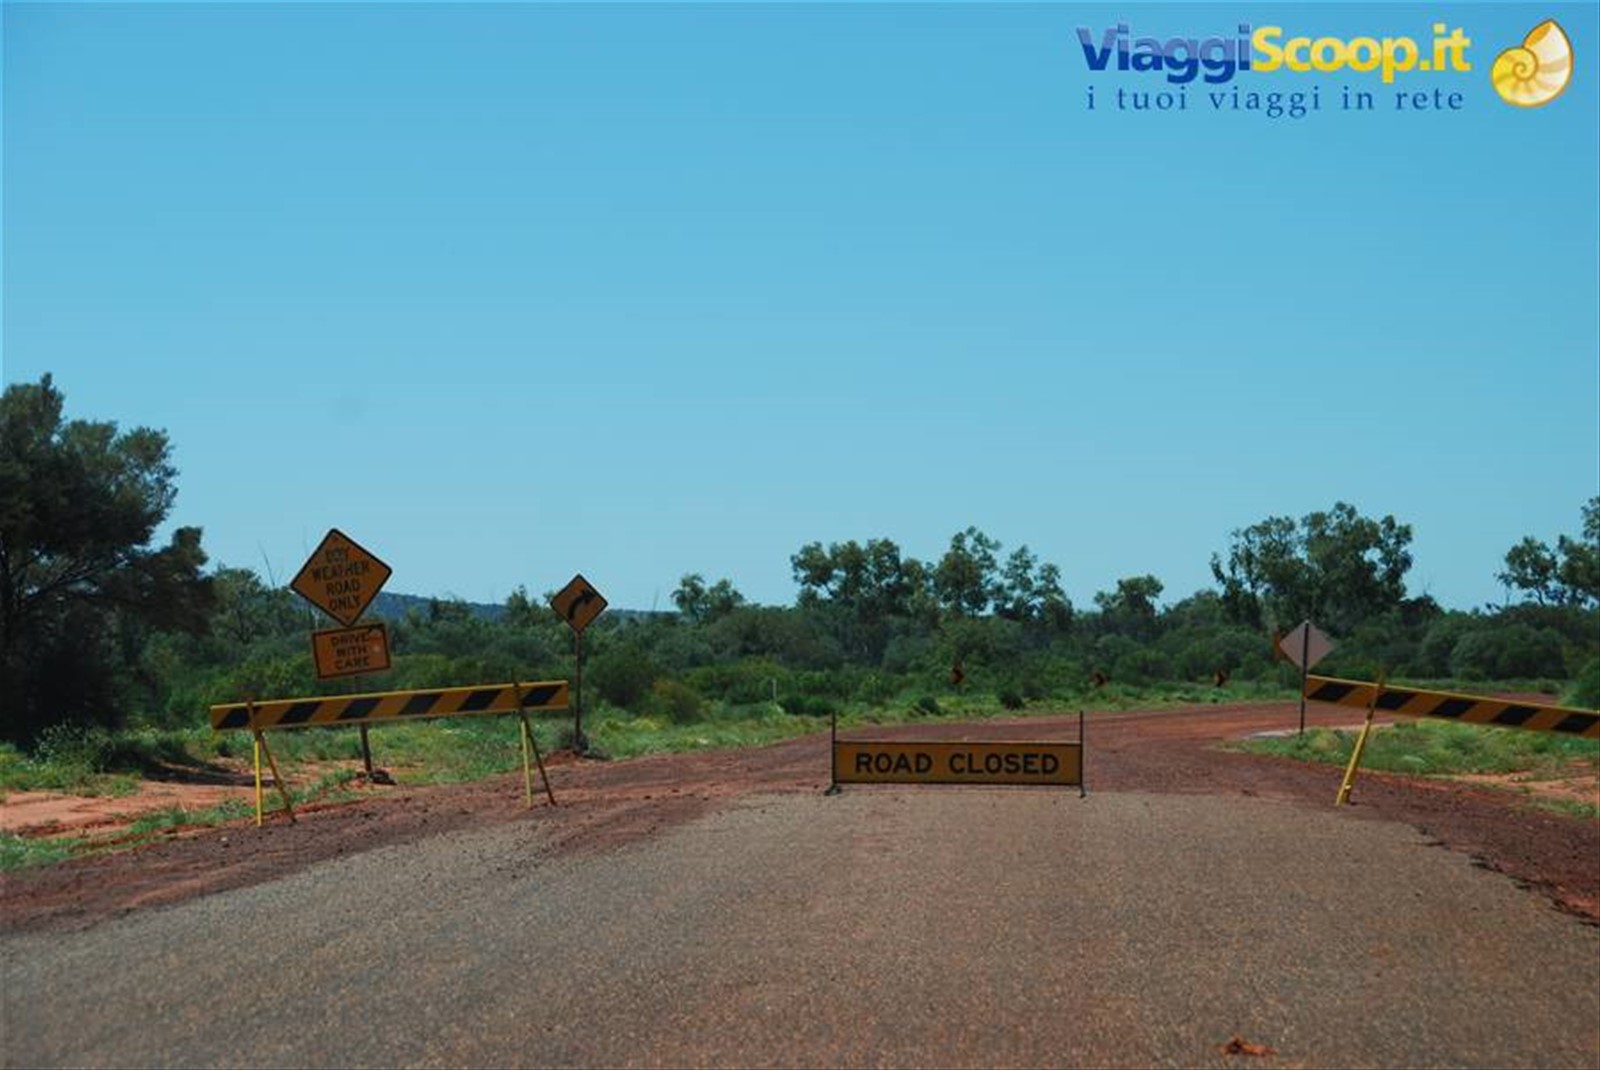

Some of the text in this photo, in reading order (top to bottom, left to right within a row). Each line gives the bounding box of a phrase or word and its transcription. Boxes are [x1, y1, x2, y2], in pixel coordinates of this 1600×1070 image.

[326, 579, 361, 595] ROAD
[328, 597, 361, 612] ONLY
[331, 632, 369, 647] DRIVE
[336, 646, 368, 658] WITH
[335, 656, 370, 670] CARE
[855, 753, 1059, 775] ROAD CLOSED
